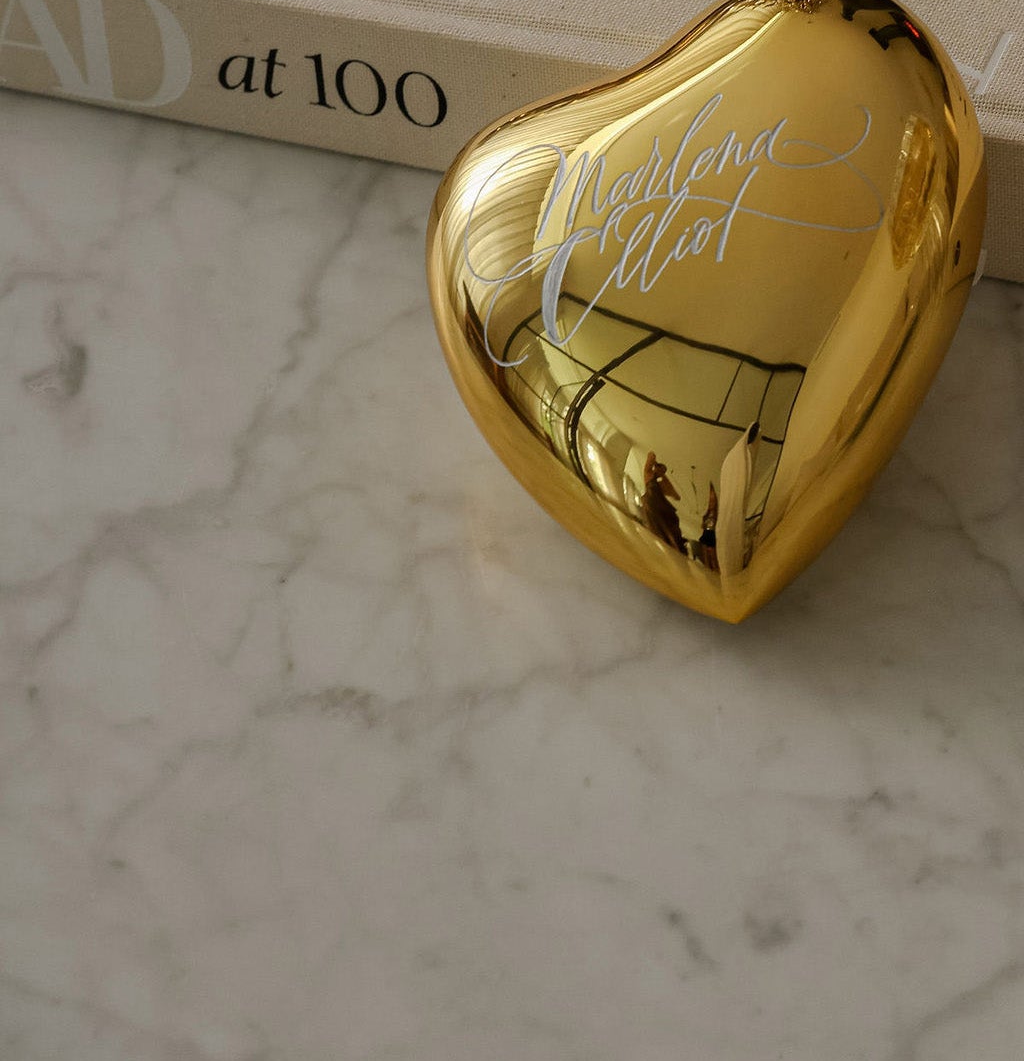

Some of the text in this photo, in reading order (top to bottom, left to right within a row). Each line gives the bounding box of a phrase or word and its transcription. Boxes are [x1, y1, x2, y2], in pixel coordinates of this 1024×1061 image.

[217, 48, 287, 99] at
[304, 52, 449, 128] 100
[466, 93, 872, 241] Marlena
[484, 164, 800, 366] Elliot
